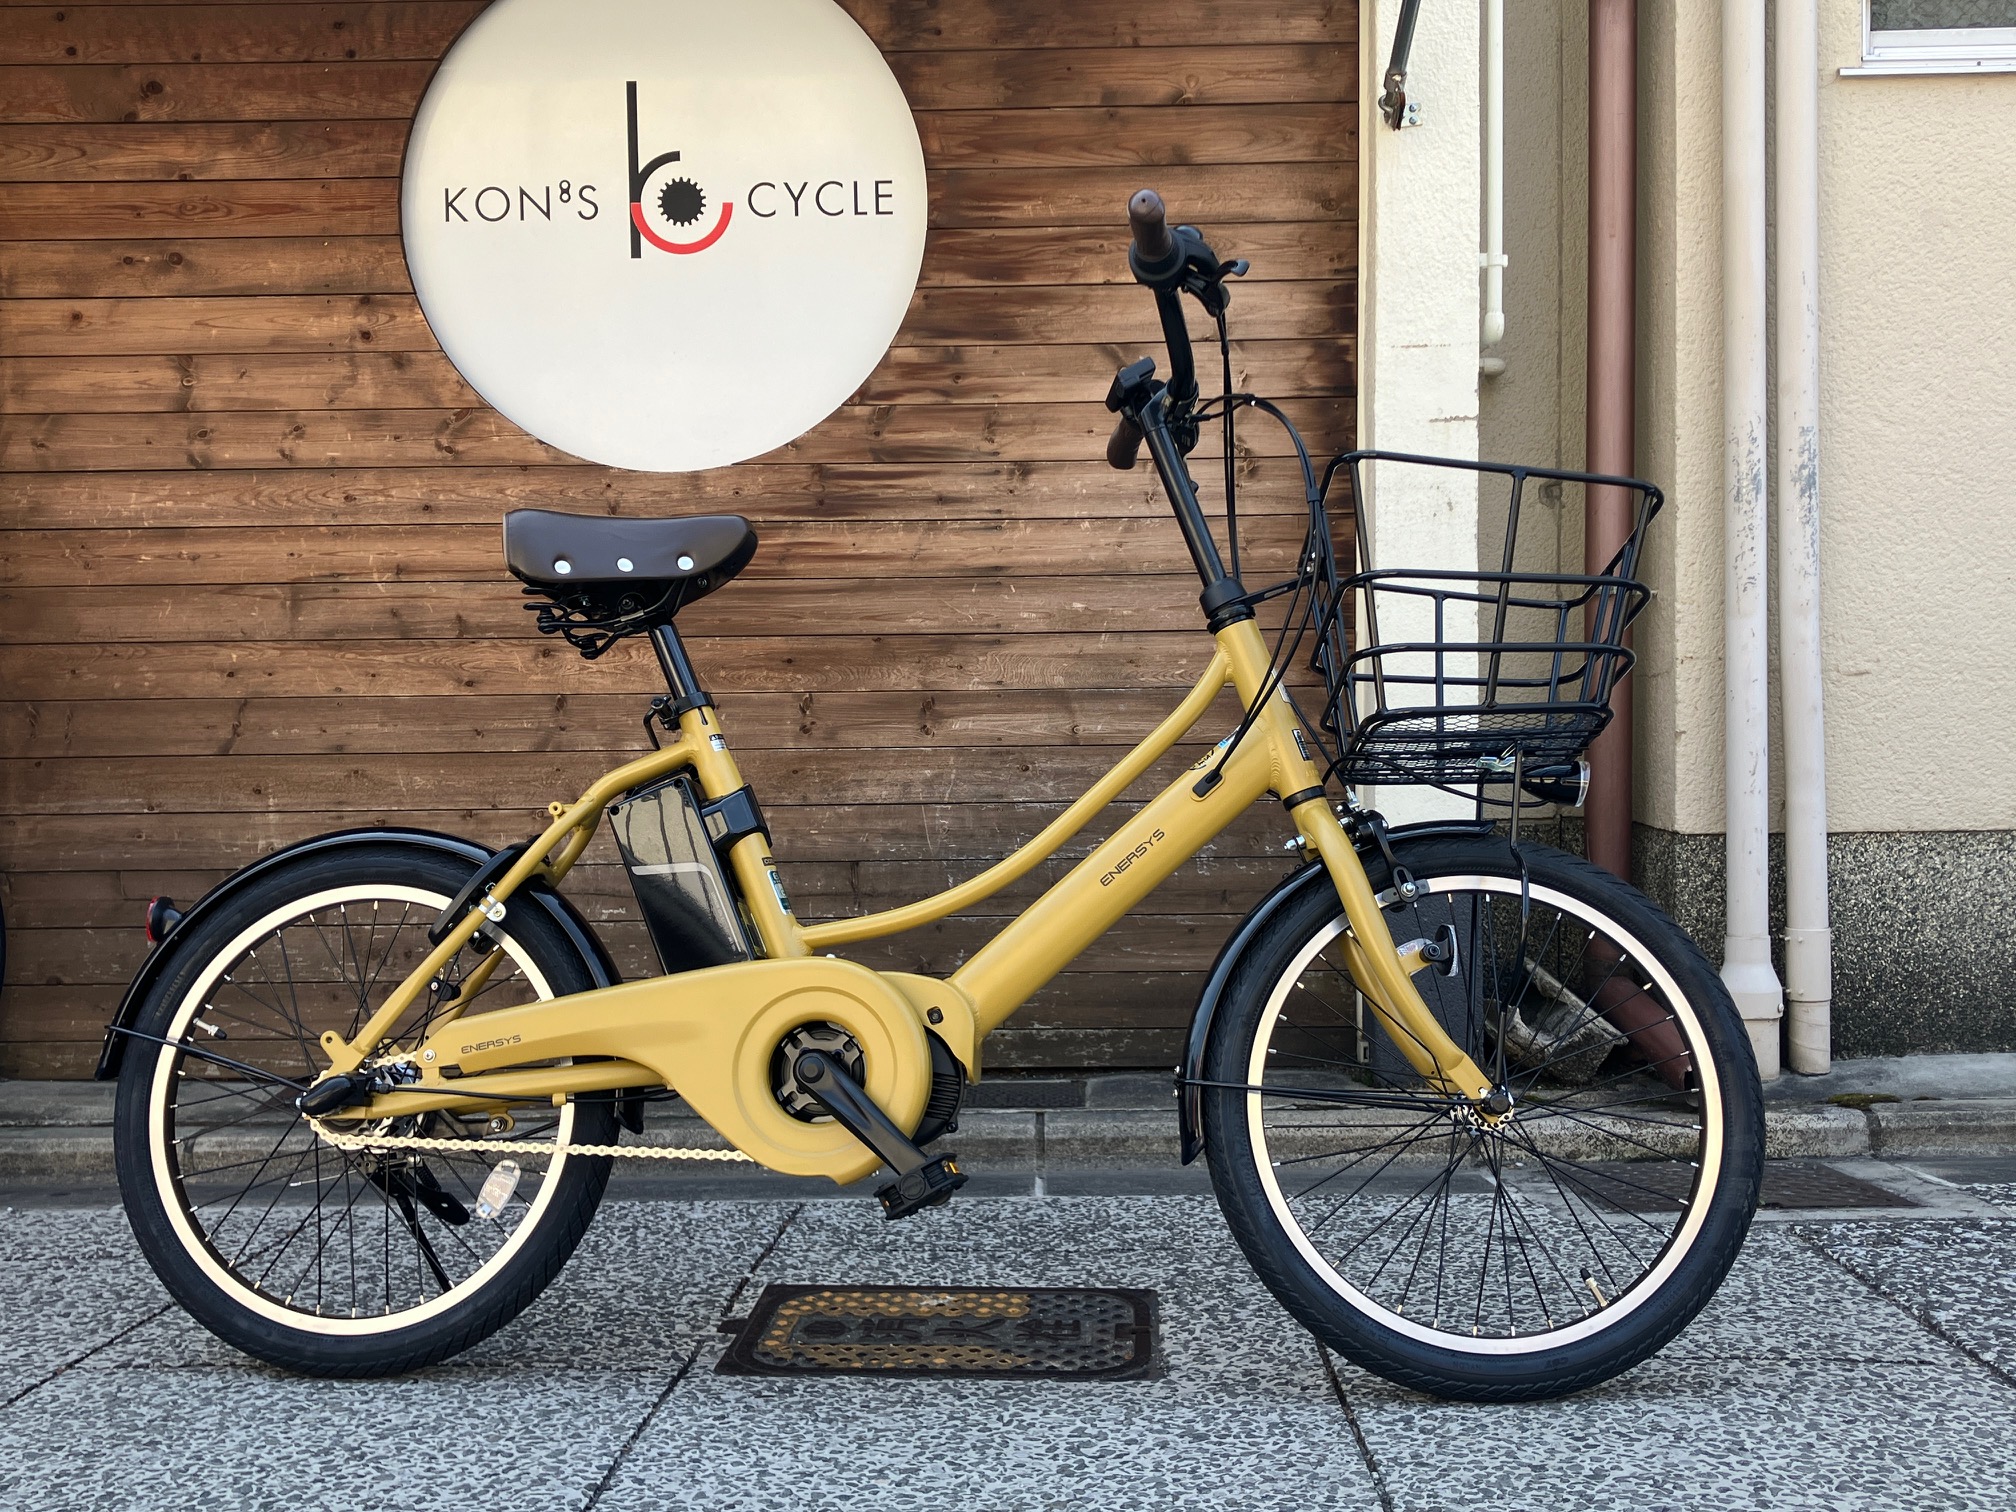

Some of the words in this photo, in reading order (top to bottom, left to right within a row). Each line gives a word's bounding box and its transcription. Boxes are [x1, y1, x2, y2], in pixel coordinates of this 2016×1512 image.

[747, 180, 894, 218] CYCLE
[1100, 828, 1165, 887] ENERSYS
[461, 1034, 522, 1054] ENERSYS
